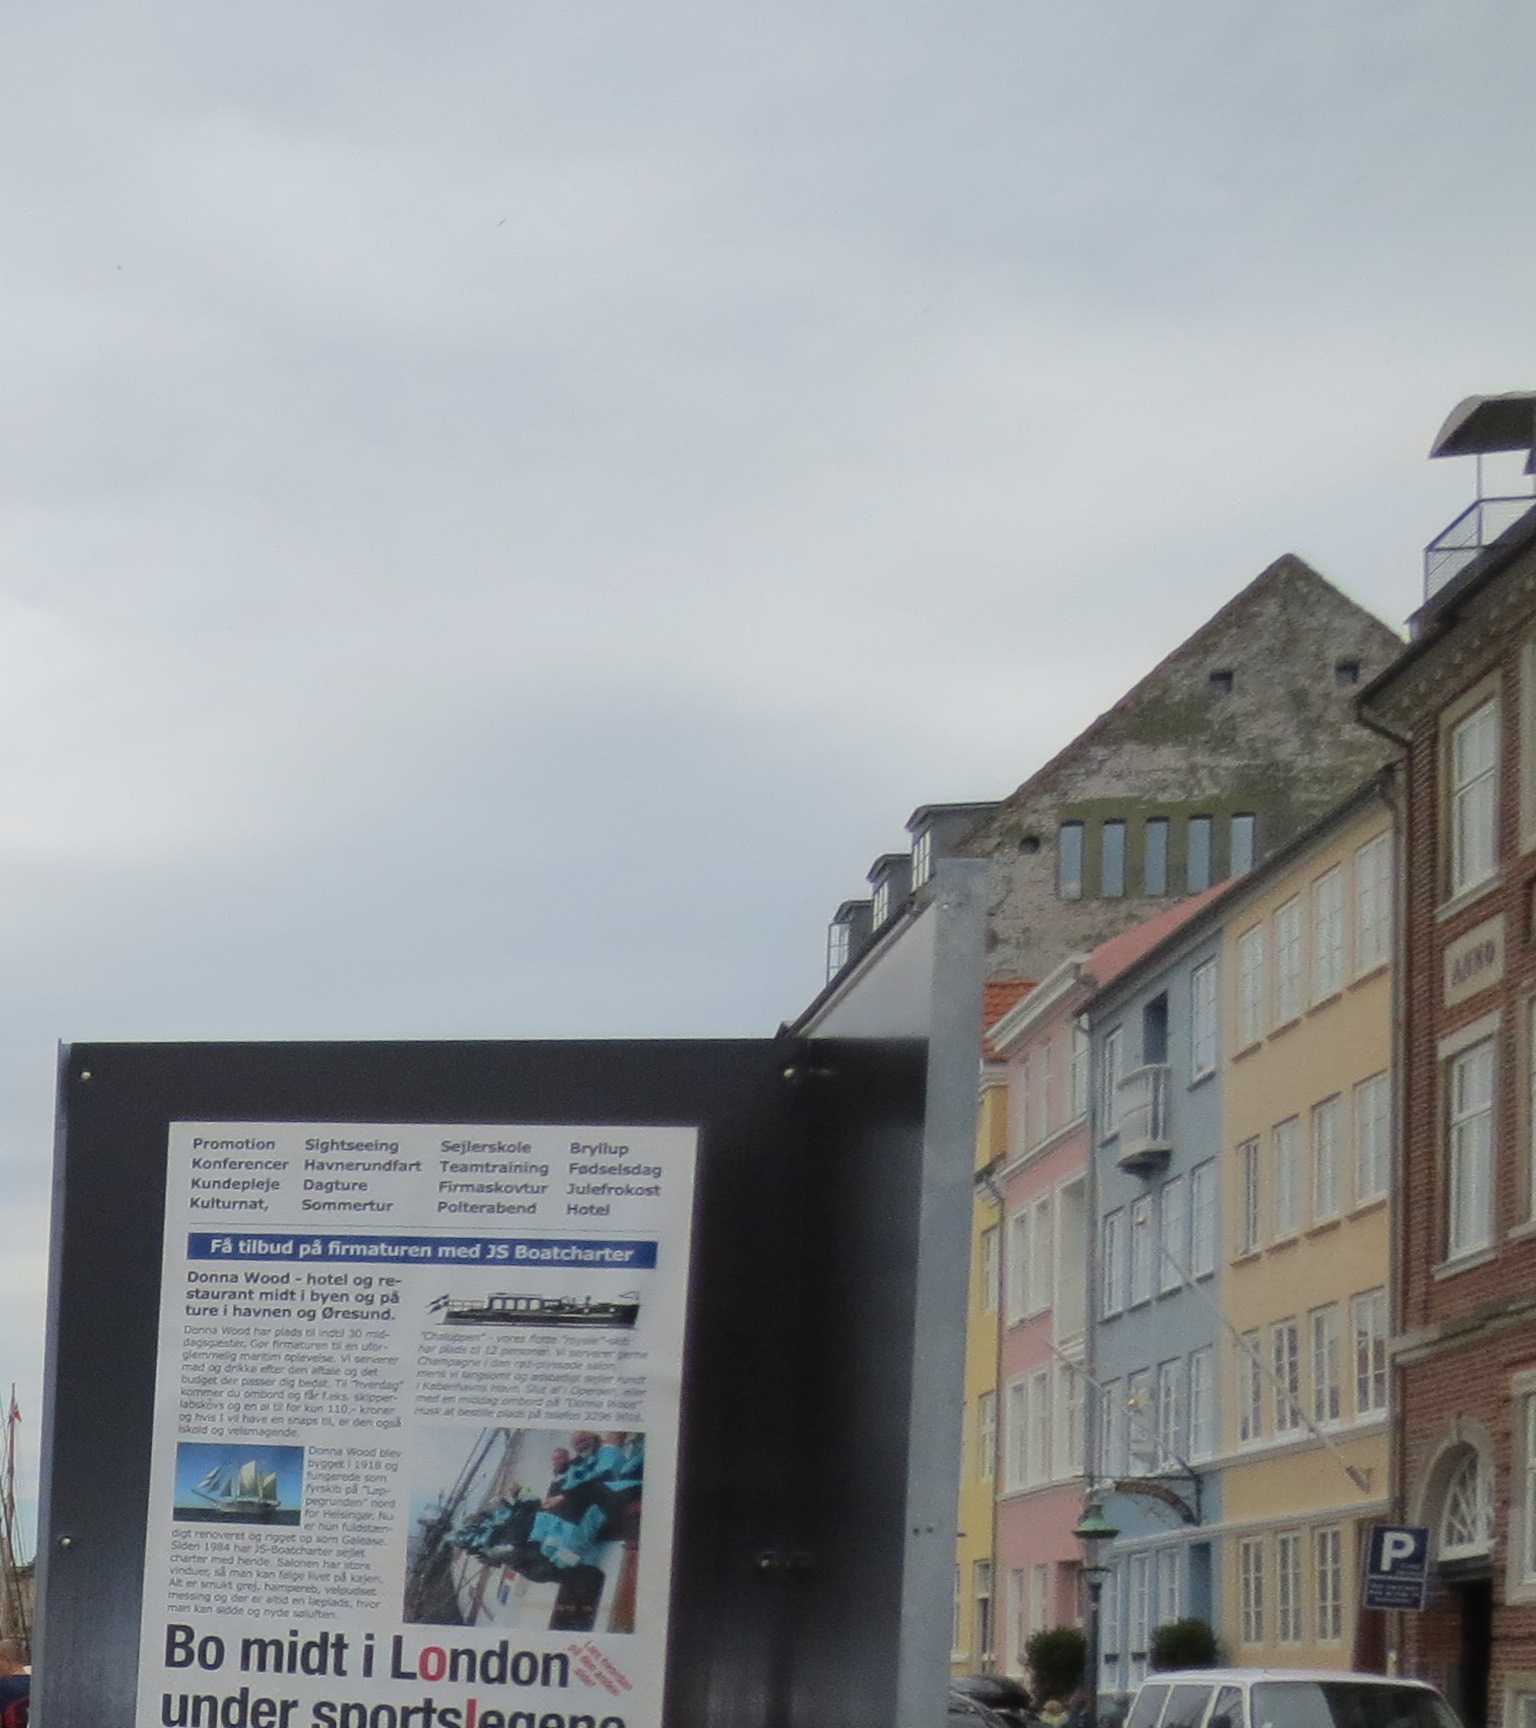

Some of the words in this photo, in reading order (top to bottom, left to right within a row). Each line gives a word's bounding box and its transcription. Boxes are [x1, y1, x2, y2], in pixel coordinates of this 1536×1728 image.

[192, 1137, 276, 1153] Promotion
[304, 1137, 400, 1156] Sightseeing
[440, 1139, 532, 1156] Sejlerskole
[569, 1141, 630, 1159] Bryllup
[191, 1156, 290, 1174] Konferencer
[303, 1158, 423, 1173] Havnerundfart
[438, 1159, 550, 1178] Teamtraining
[568, 1161, 663, 1180] Fødselsdag
[190, 1176, 281, 1194] Kundepleje
[302, 1178, 369, 1195] Dagture
[438, 1180, 550, 1195] Firmaskovtur
[566, 1182, 662, 1197] Julefrokost
[189, 1194, 270, 1213] Kulturnat,
[301, 1198, 395, 1213] Sommertur
[437, 1200, 538, 1215] Polterabend
[565, 1202, 611, 1217] Hotel
[210, 1237, 233, 1254] Få
[238, 1239, 293, 1255] tilbud
[299, 1239, 322, 1259] på
[328, 1240, 432, 1257] firmaturen
[438, 1243, 481, 1258] med
[486, 1244, 509, 1259] JS
[515, 1244, 634, 1262] Boatcharter
[187, 1270, 239, 1284] Donna
[243, 1271, 291, 1285] Wood
[306, 1272, 349, 1286] hotel
[352, 1276, 374, 1290] og
[378, 1276, 402, 1287] re-
[185, 1287, 255, 1301] staurant
[258, 1288, 297, 1302] midt
[300, 1289, 306, 1302] i
[310, 1289, 350, 1305] byen
[354, 1293, 375, 1306] og
[379, 1290, 400, 1307] på
[185, 1304, 220, 1317] ture
[222, 1304, 228, 1317] i
[232, 1304, 292, 1319] havnen
[296, 1308, 317, 1322] og
[321, 1306, 395, 1321] Øresund.
[204, 1541, 231, 1553] 1984
[1381, 1531, 1416, 1571] P
[165, 1624, 225, 1671] Bo
[240, 1629, 349, 1677] midt
[362, 1633, 374, 1678] i
[390, 1634, 570, 1688] London
